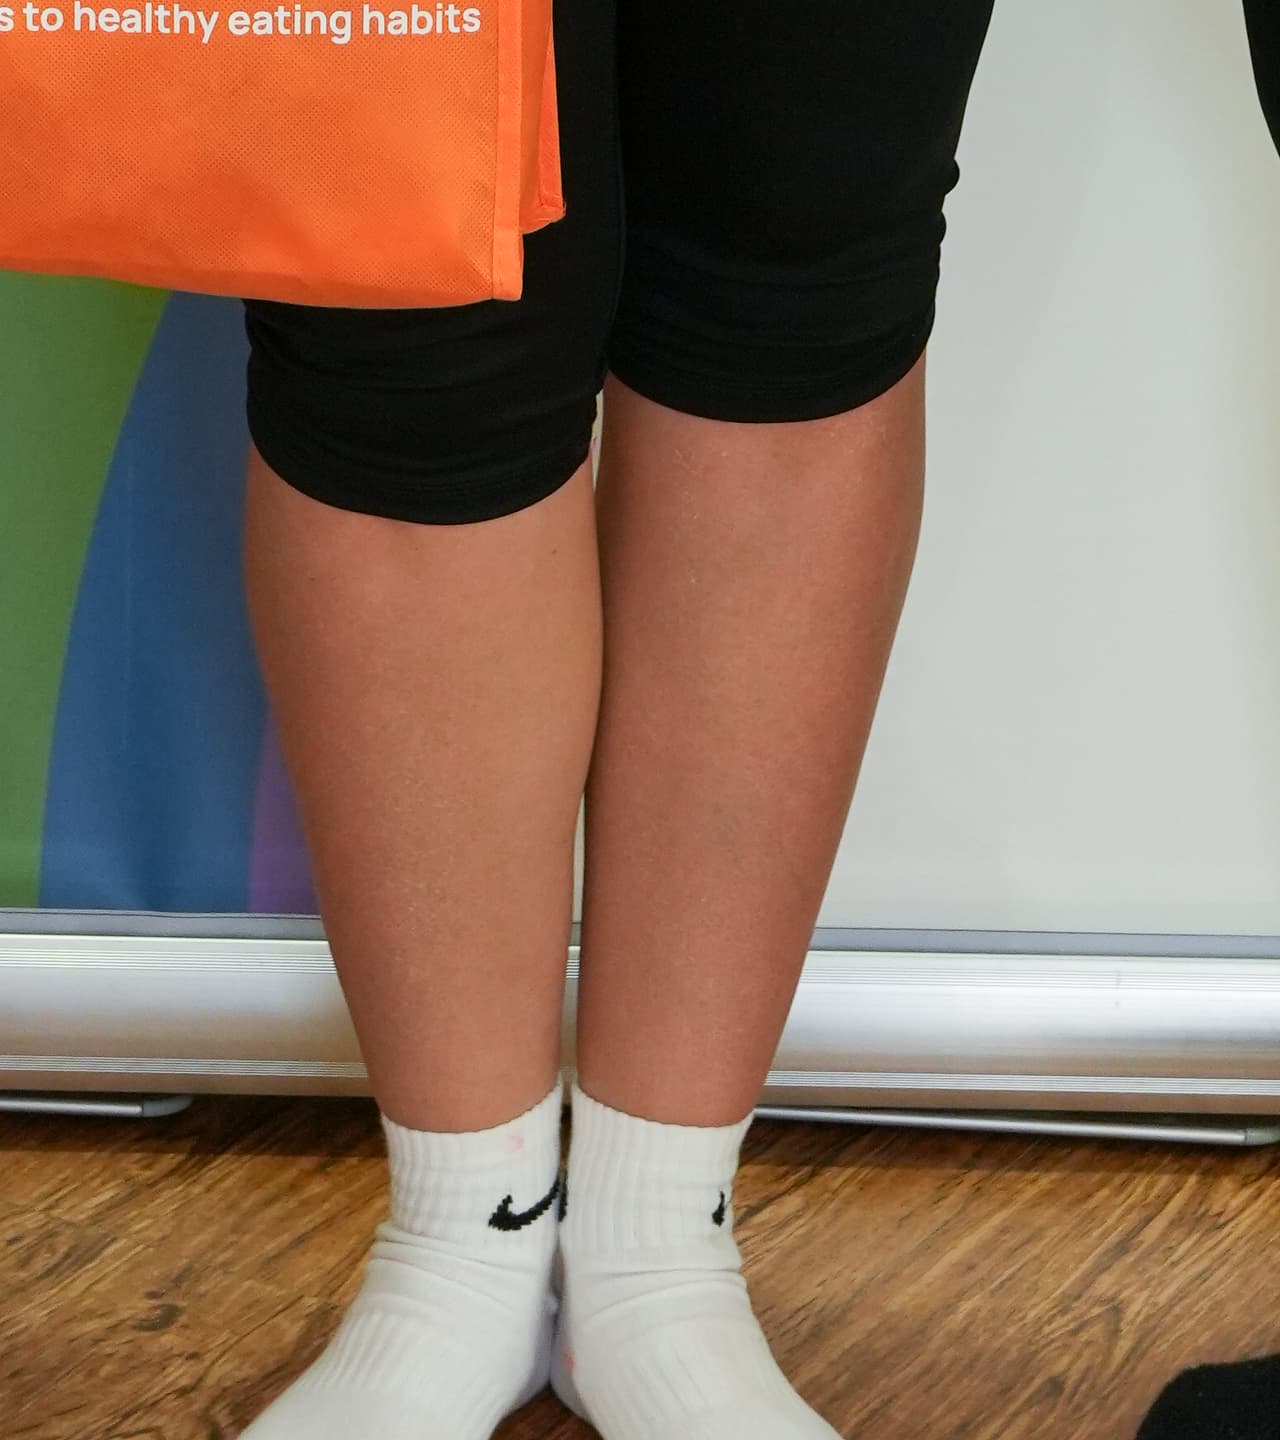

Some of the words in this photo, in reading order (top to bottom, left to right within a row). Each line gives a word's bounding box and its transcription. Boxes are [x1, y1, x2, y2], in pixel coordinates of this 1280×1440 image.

[22, 1, 65, 32] to
[73, 0, 220, 45] healthy
[227, 3, 353, 46] eating
[362, 2, 481, 36] habits
